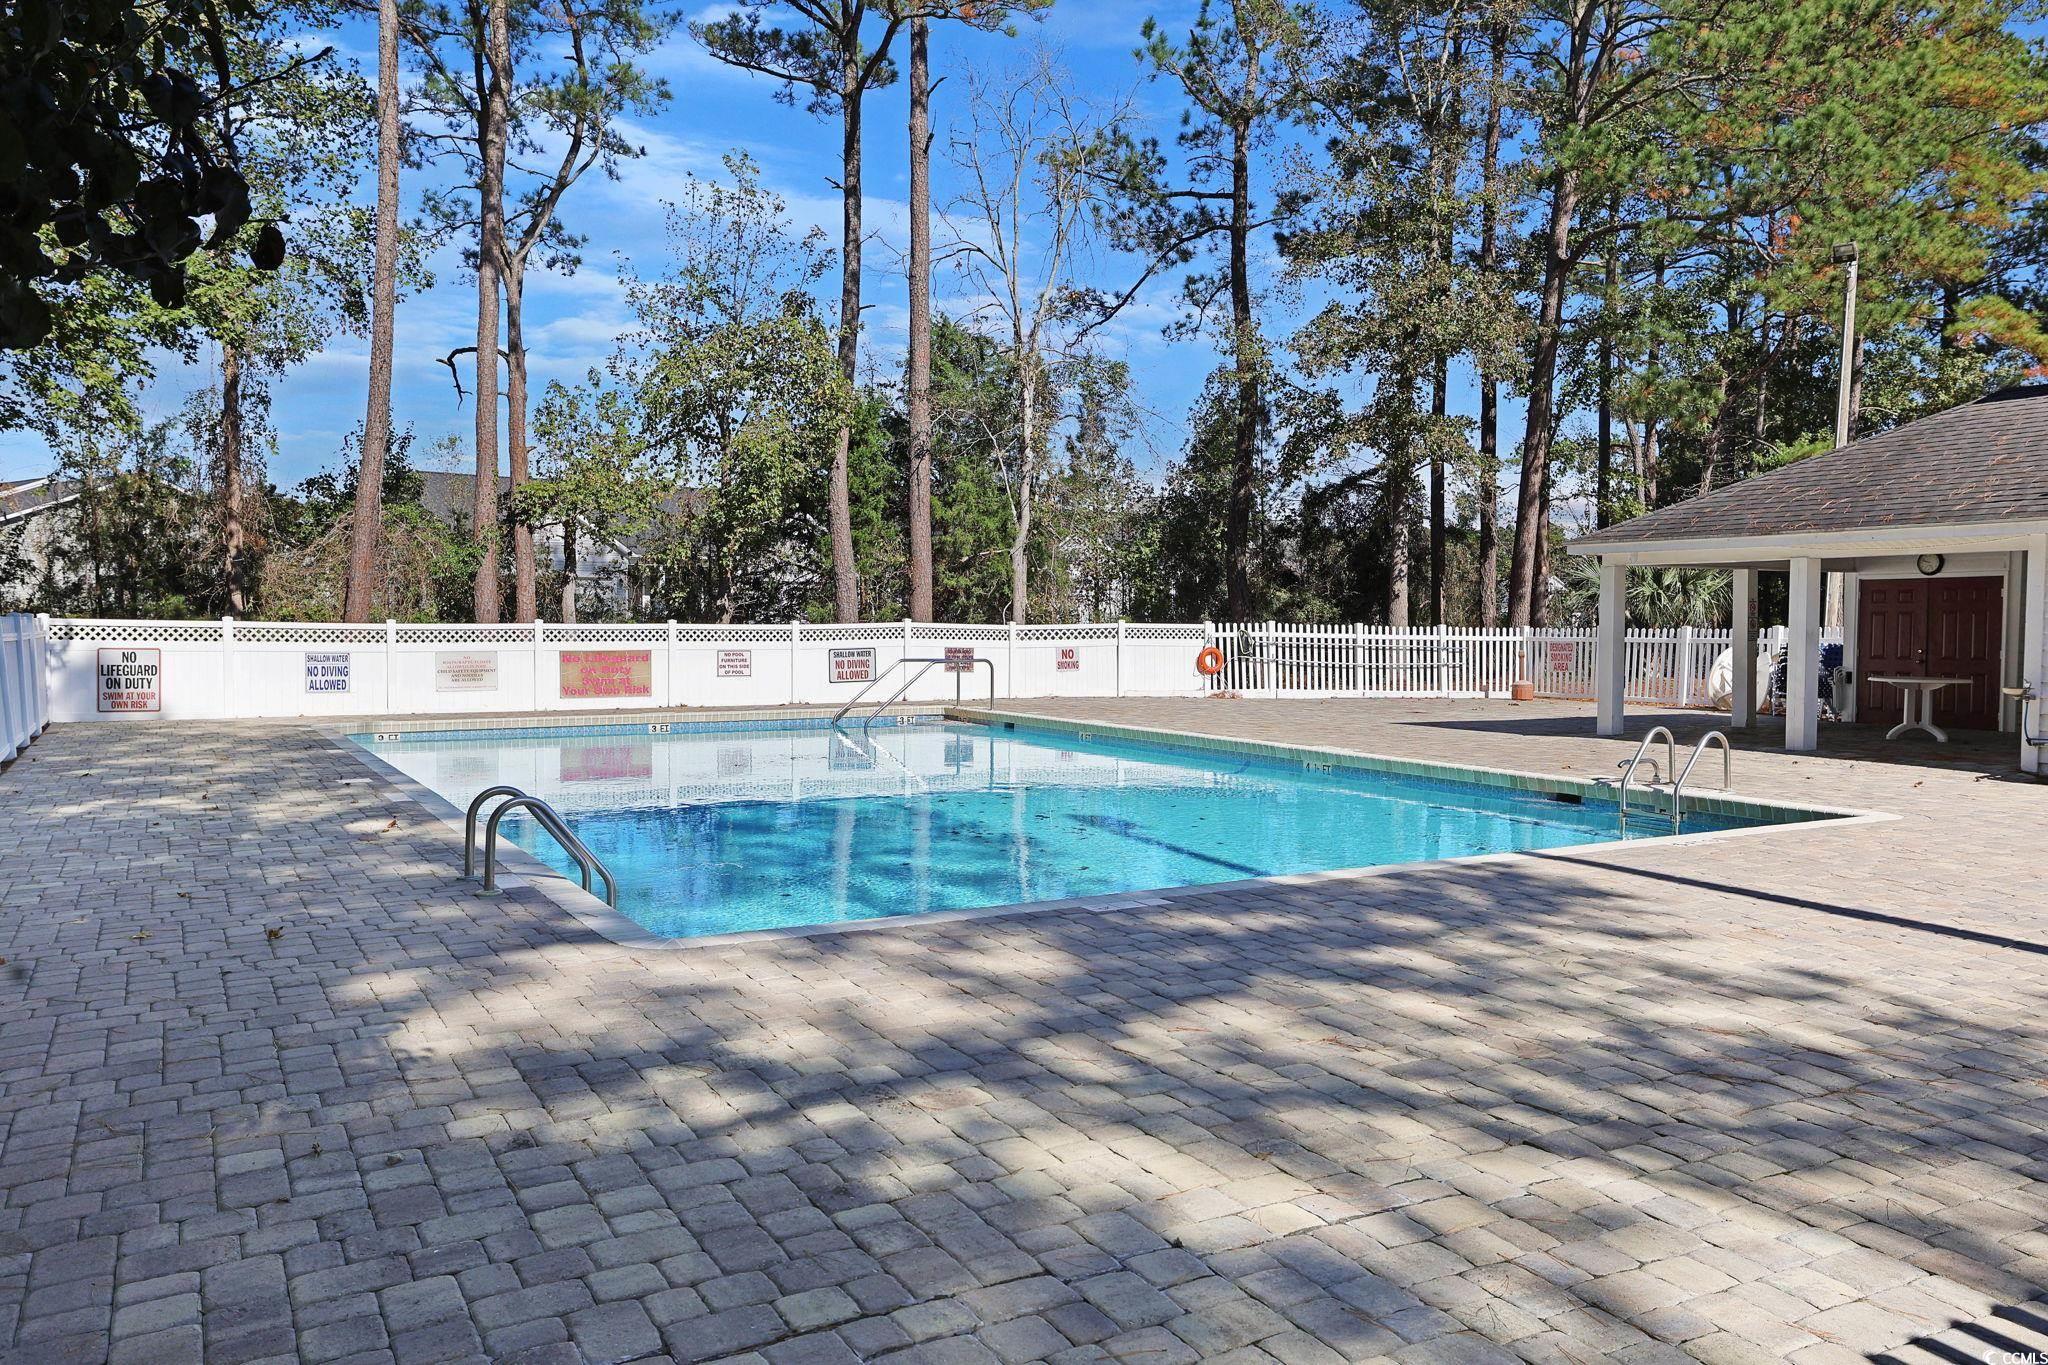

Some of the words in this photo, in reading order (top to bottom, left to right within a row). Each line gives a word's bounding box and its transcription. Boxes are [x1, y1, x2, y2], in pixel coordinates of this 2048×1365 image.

[122, 651, 137, 663] NO
[307, 654, 330, 662] SHALLOW
[331, 654, 349, 662] WATER
[562, 654, 580, 663] No
[585, 653, 649, 663] Lifeguard
[1061, 649, 1074, 659] NO
[1551, 652, 1572, 662] SMOKING
[835, 660, 845, 669] NO
[847, 659, 870, 669] DIVING
[1057, 661, 1079, 669] SMOKING
[1553, 663, 1569, 672] AREA
[100, 664, 158, 676] LIFEGUARD
[307, 666, 319, 677] NO
[321, 666, 349, 677] DIVING
[837, 670, 869, 680] ALLOWED
[105, 677, 121, 689] ON
[125, 677, 152, 689] DUTY
[309, 679, 347, 690] ALLOWED
[562, 686, 589, 695] Your
[594, 686, 620, 695] Own
[624, 685, 649, 694] Risk
[102, 692, 124, 700] SWIM
[126, 692, 134, 700] AT
[136, 692, 156, 700] YOUR
[111, 700, 128, 709] OWN
[130, 700, 148, 709] RISK
